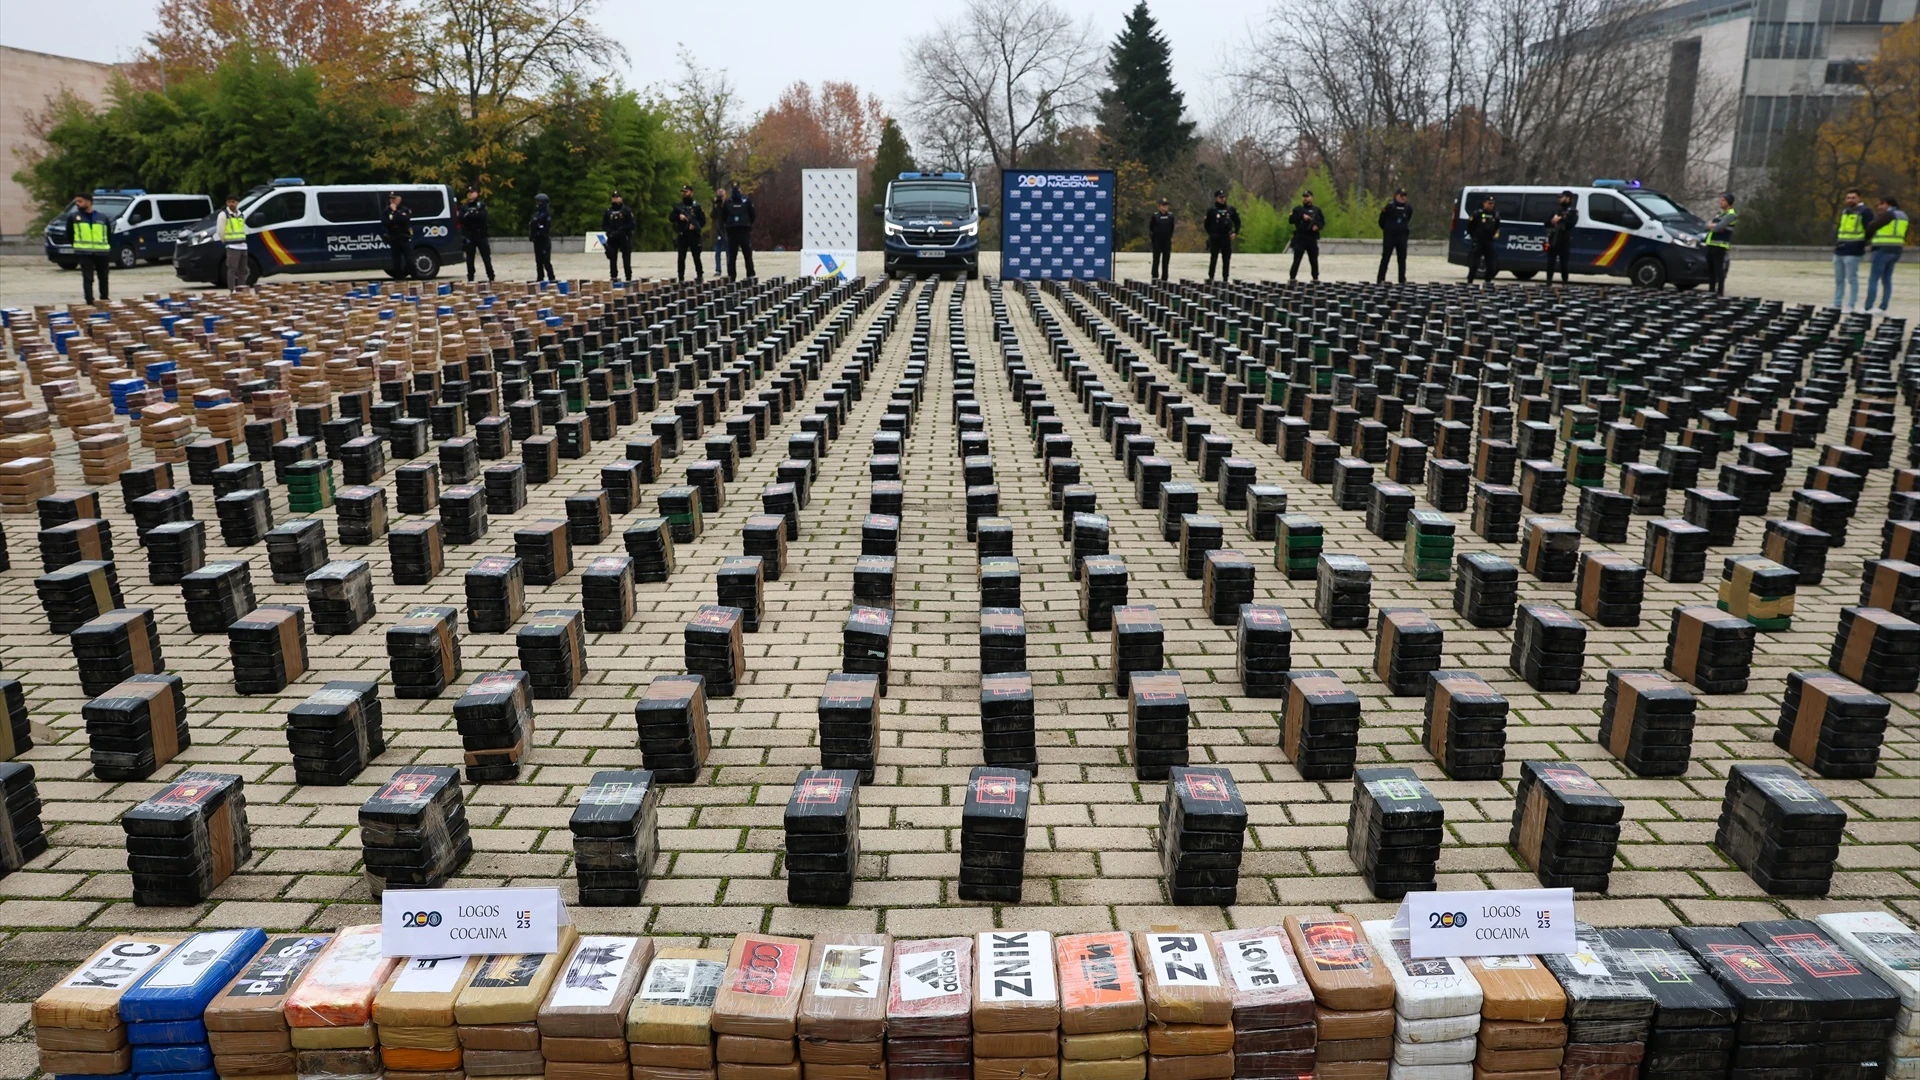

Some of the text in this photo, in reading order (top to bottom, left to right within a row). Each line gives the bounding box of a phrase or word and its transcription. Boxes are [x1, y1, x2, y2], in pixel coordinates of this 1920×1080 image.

[1018, 175, 1047, 188] 200
[422, 226, 448, 238] 200
[1506, 242, 1543, 251] NACIO
[458, 905, 500, 918] LOGOS
[1482, 905, 1521, 918] LOGOS
[402, 911, 443, 928] 200
[516, 919, 531, 929] 23
[1429, 911, 1468, 929] 200
[1537, 919, 1551, 929] 23
[449, 927, 508, 940] COCAINA
[1475, 927, 1530, 941] COCAINA
[993, 932, 1033, 997] ZNIK
[1157, 936, 1208, 981] R-Z
[1239, 940, 1280, 987] LOVE
[70, 943, 161, 988] KFC
[941, 950, 959, 993] adidas
